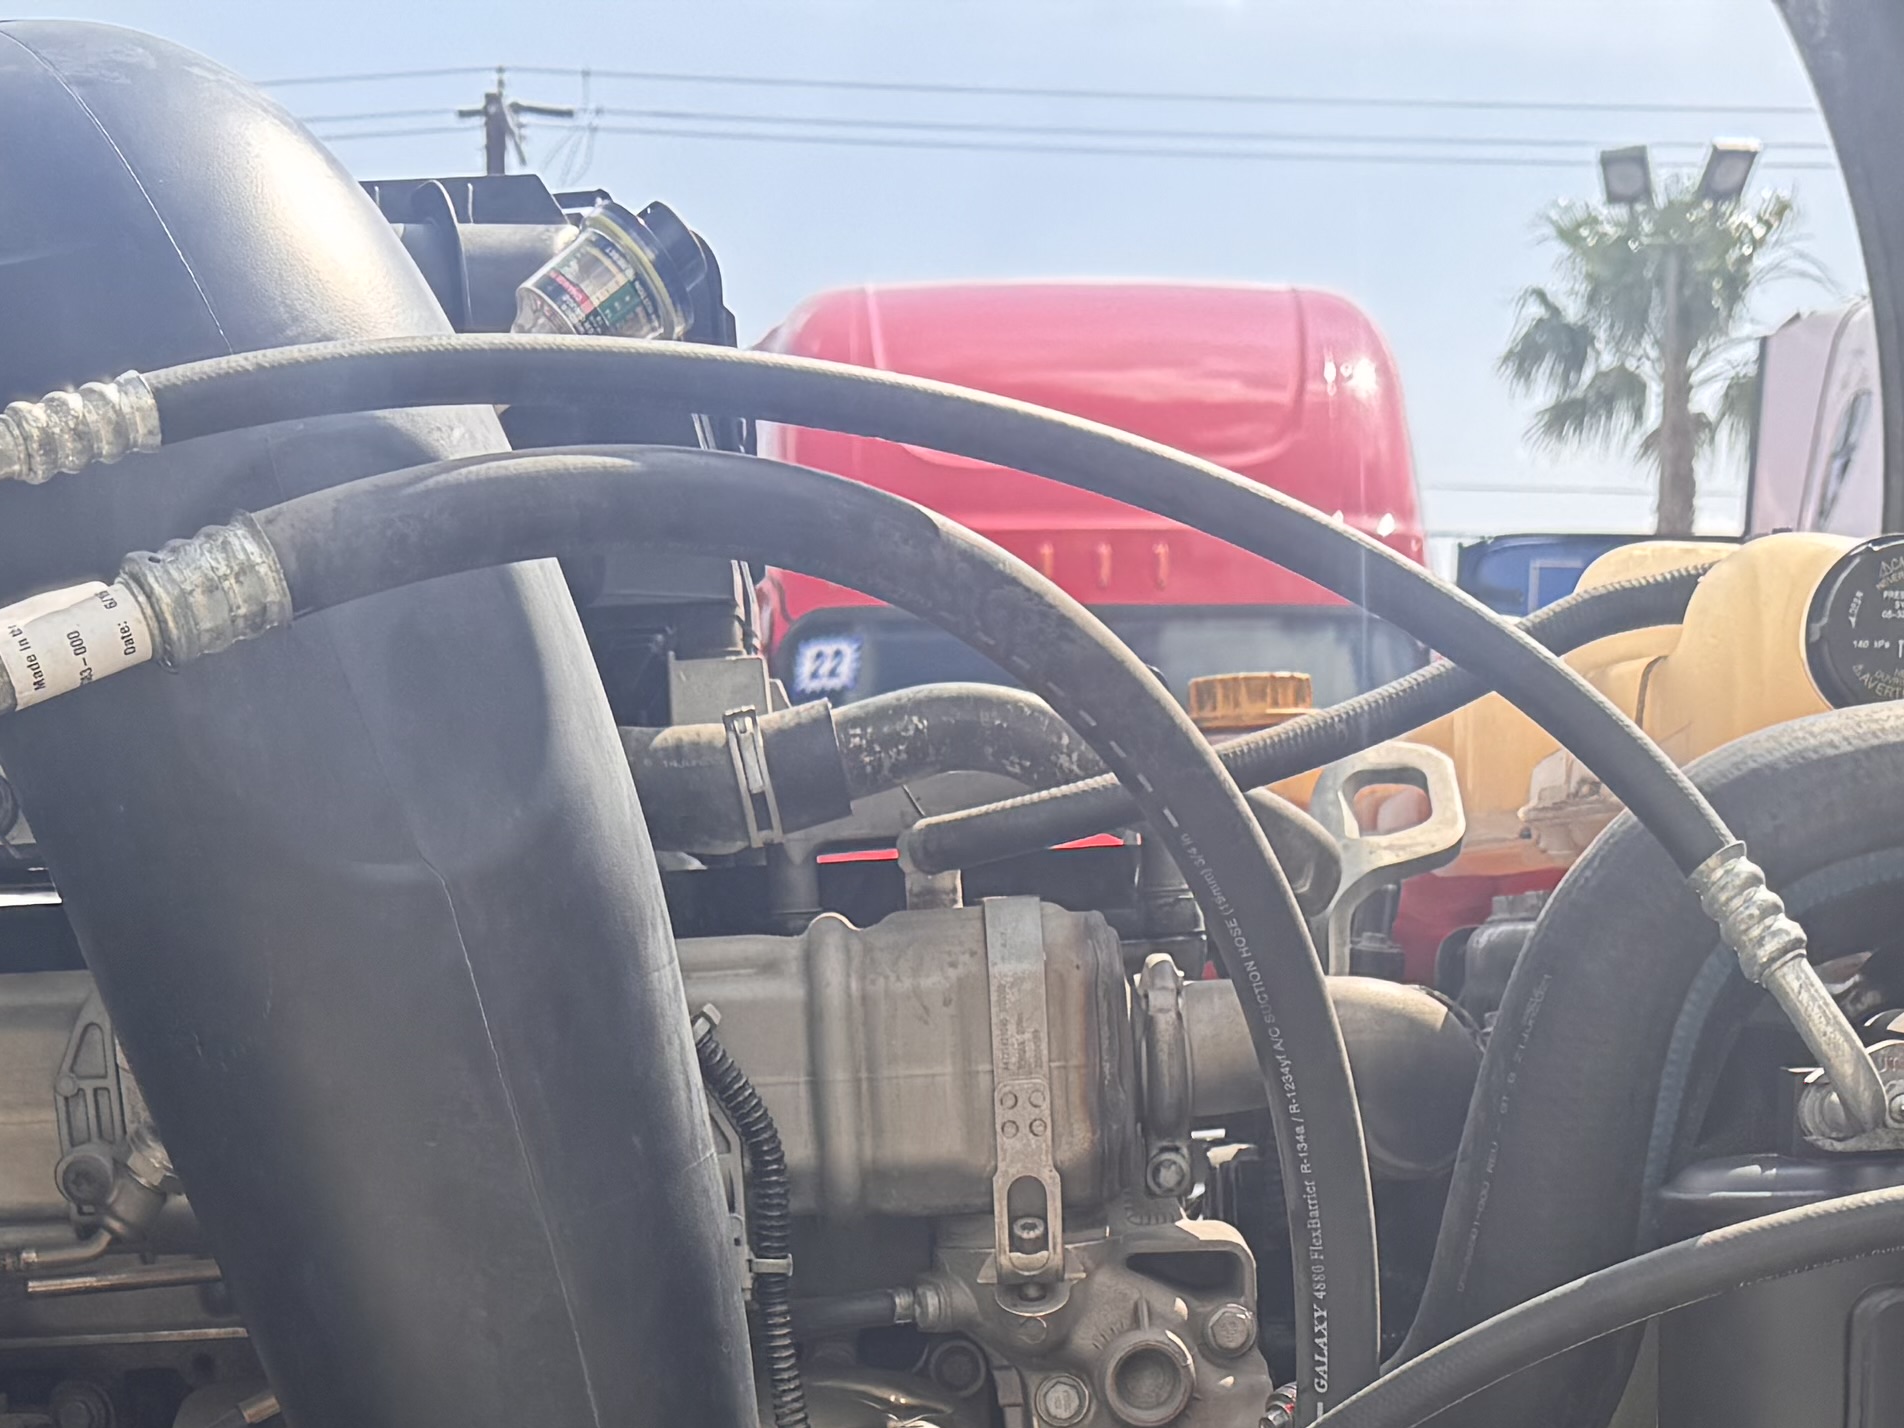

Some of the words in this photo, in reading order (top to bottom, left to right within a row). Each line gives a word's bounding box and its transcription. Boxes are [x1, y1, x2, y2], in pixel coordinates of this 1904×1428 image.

[27, 653, 46, 691] Made
[1224, 917, 1252, 958] HOSE
[1245, 960, 1275, 1024] SUCTION
[1268, 1026, 1284, 1051] A/C
[1313, 1304, 1329, 1394] GALAXY
